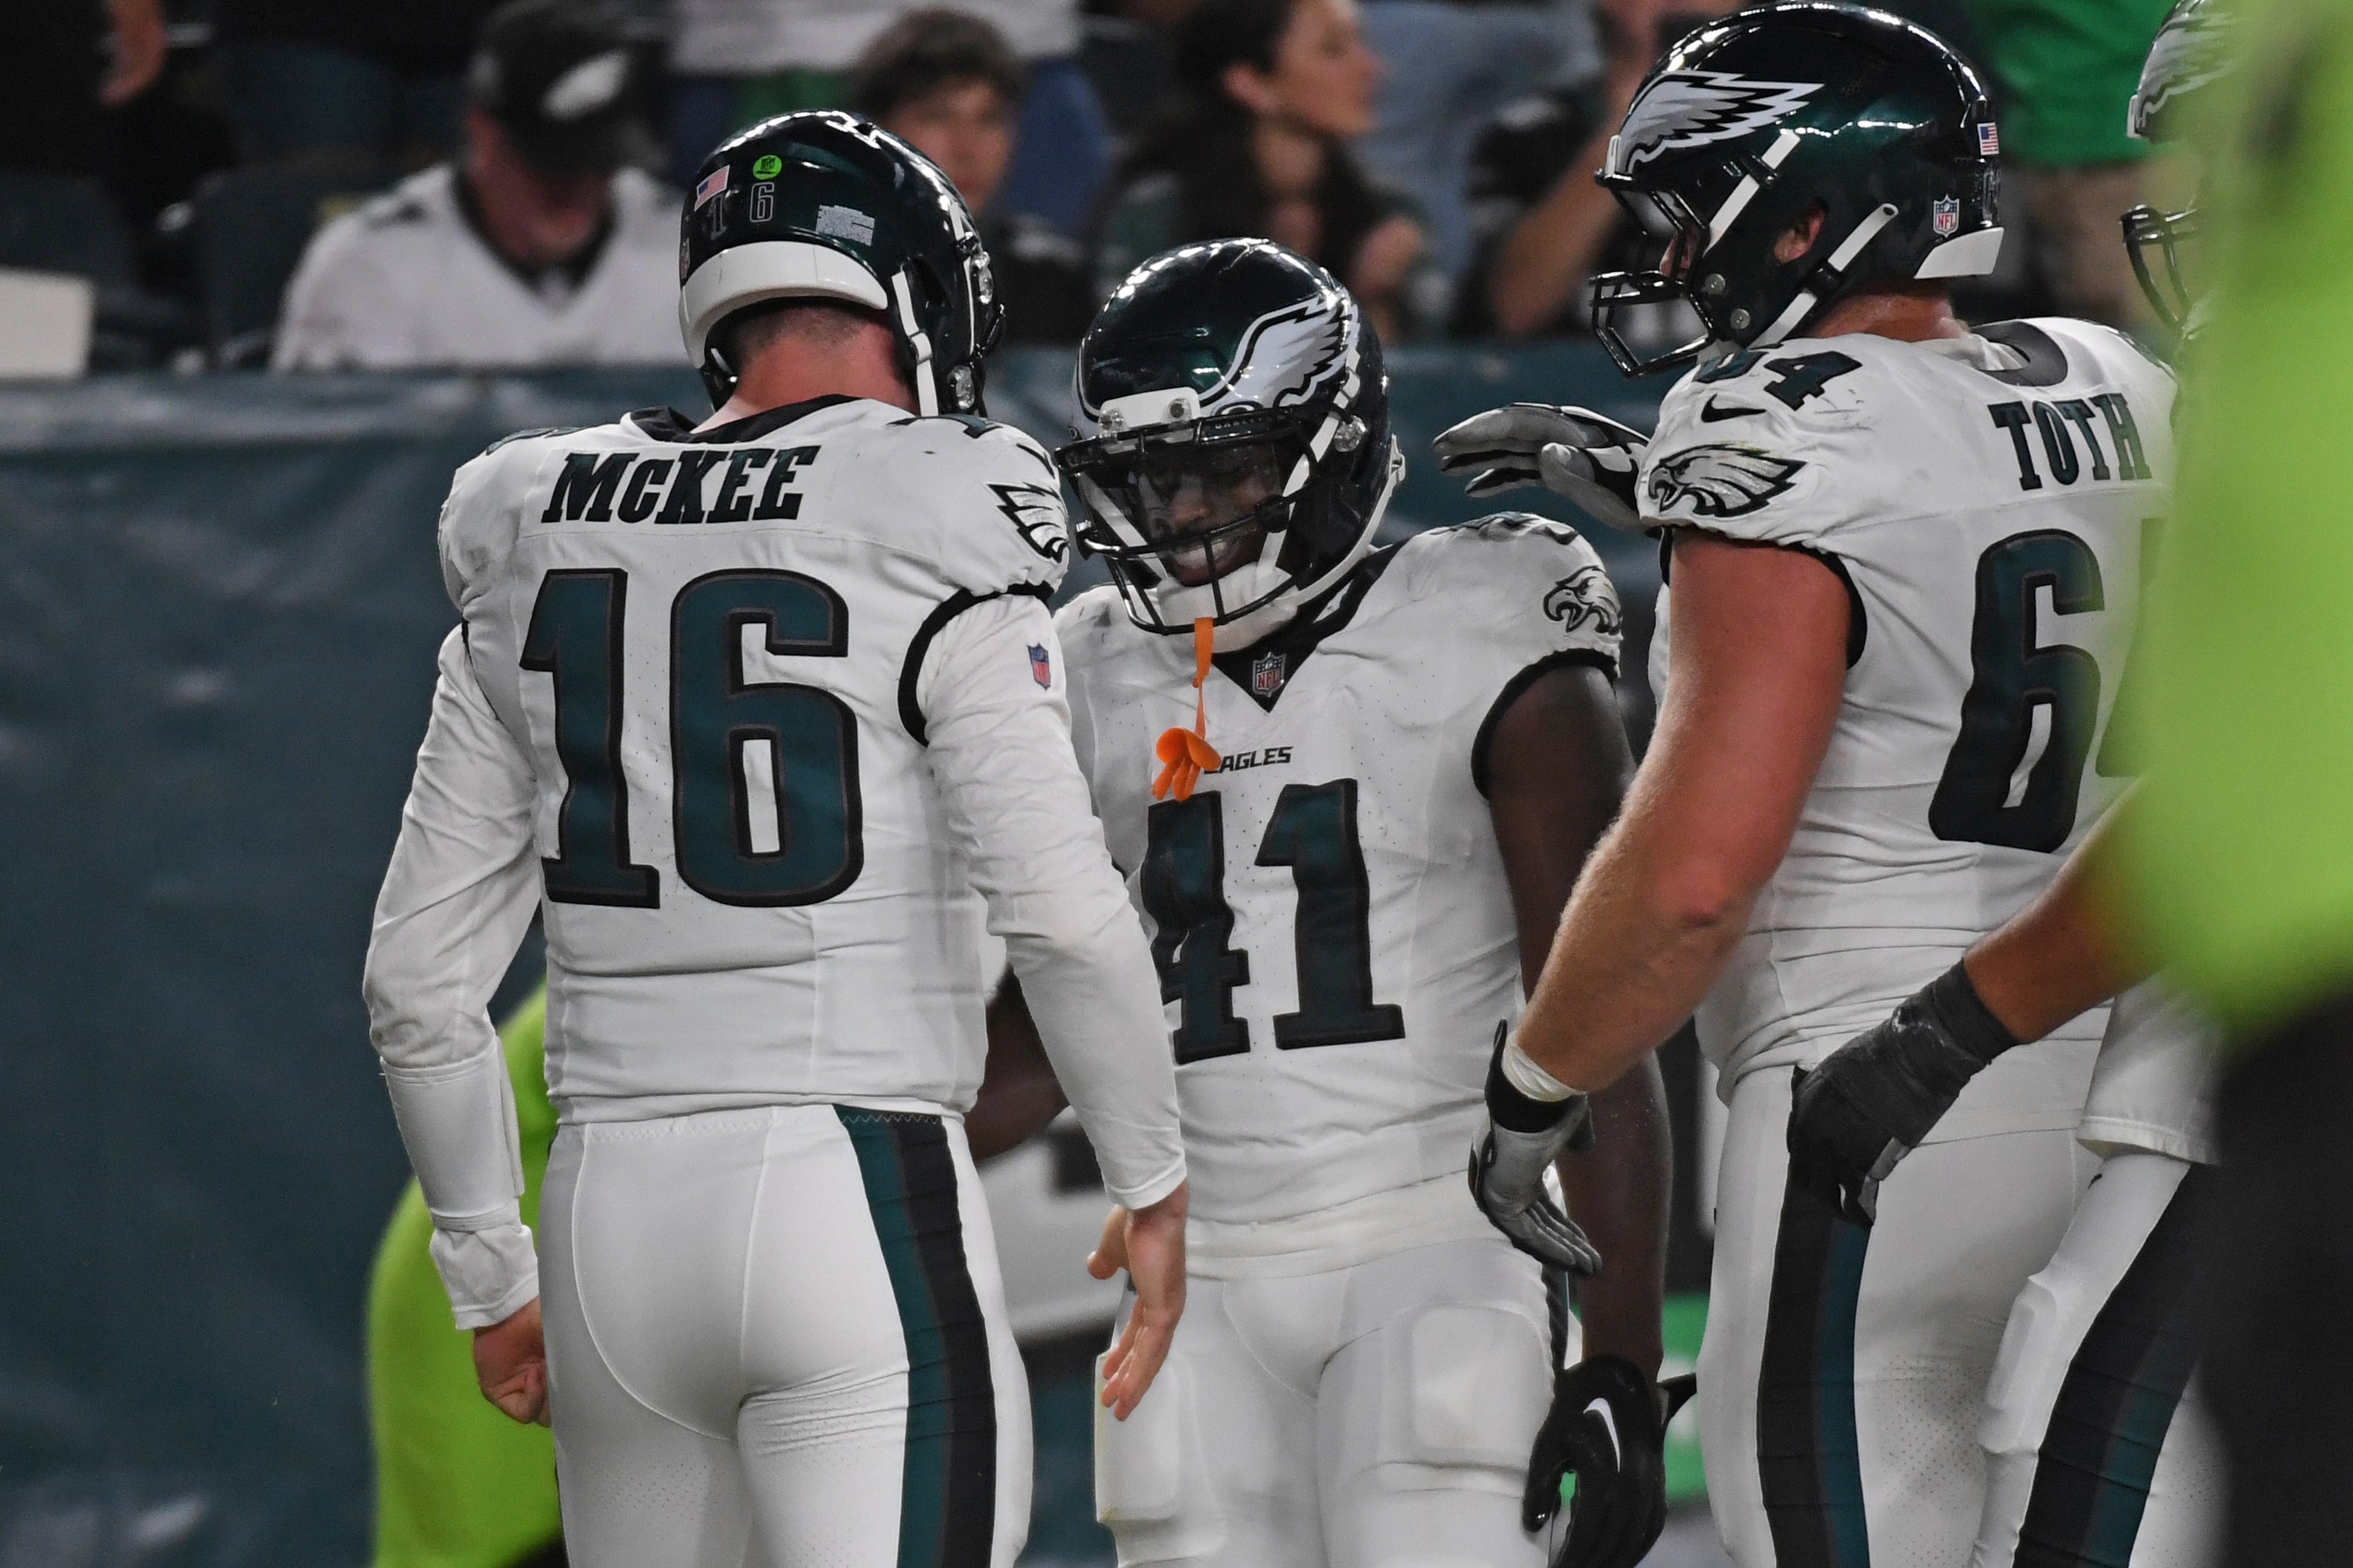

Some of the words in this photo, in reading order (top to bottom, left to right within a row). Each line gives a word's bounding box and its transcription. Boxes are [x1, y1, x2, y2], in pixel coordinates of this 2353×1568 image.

[1937, 214, 1955, 229] NFL
[1987, 393, 2152, 490] TOTH
[520, 568, 864, 908] 16
[1204, 746, 1293, 774] AGLES
[1140, 778, 1405, 1064] 41
